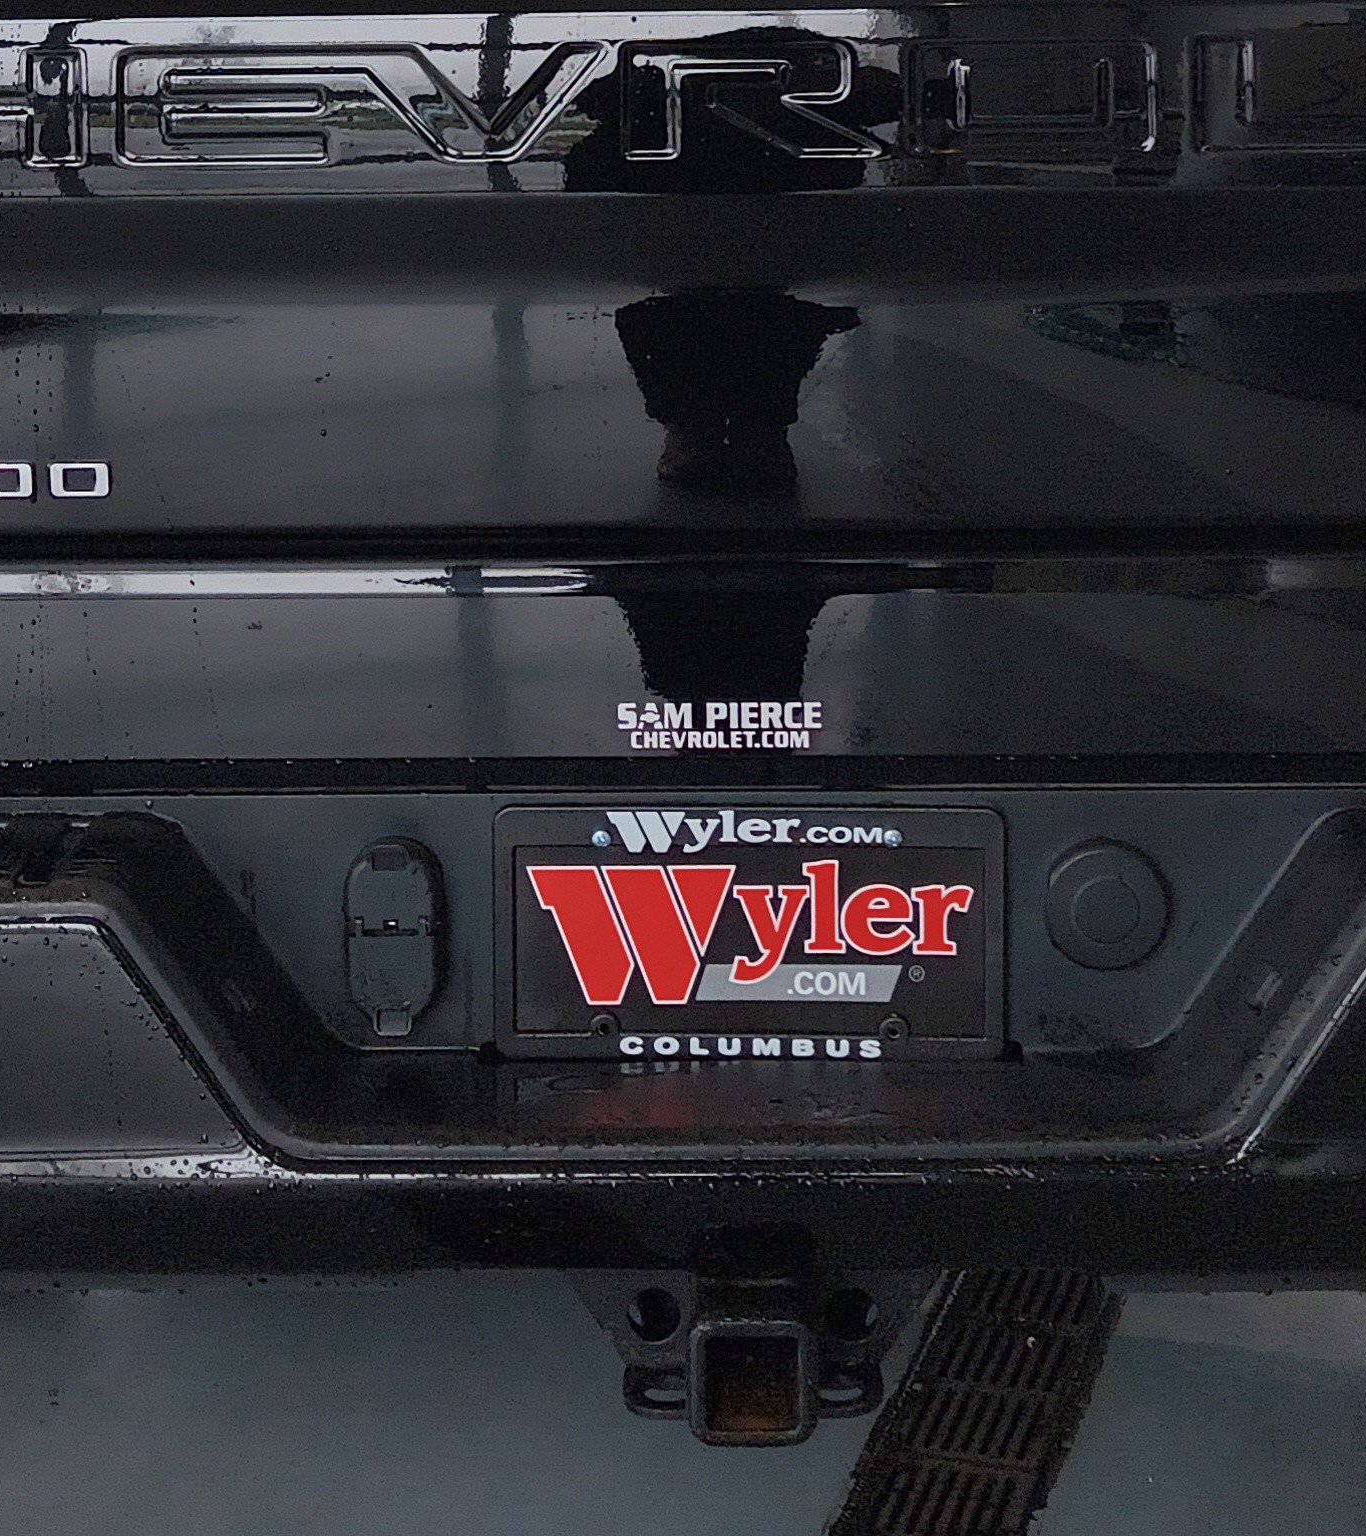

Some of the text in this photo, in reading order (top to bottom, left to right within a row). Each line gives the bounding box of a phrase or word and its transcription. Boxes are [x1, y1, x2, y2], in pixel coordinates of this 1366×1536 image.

[617, 701, 823, 730] SAM PIERCE
[630, 730, 810, 750] CHEVROLET.COM
[526, 858, 975, 1006] Wyler
[786, 970, 867, 996] .COM
[619, 1036, 883, 1059] COLUMBUS
